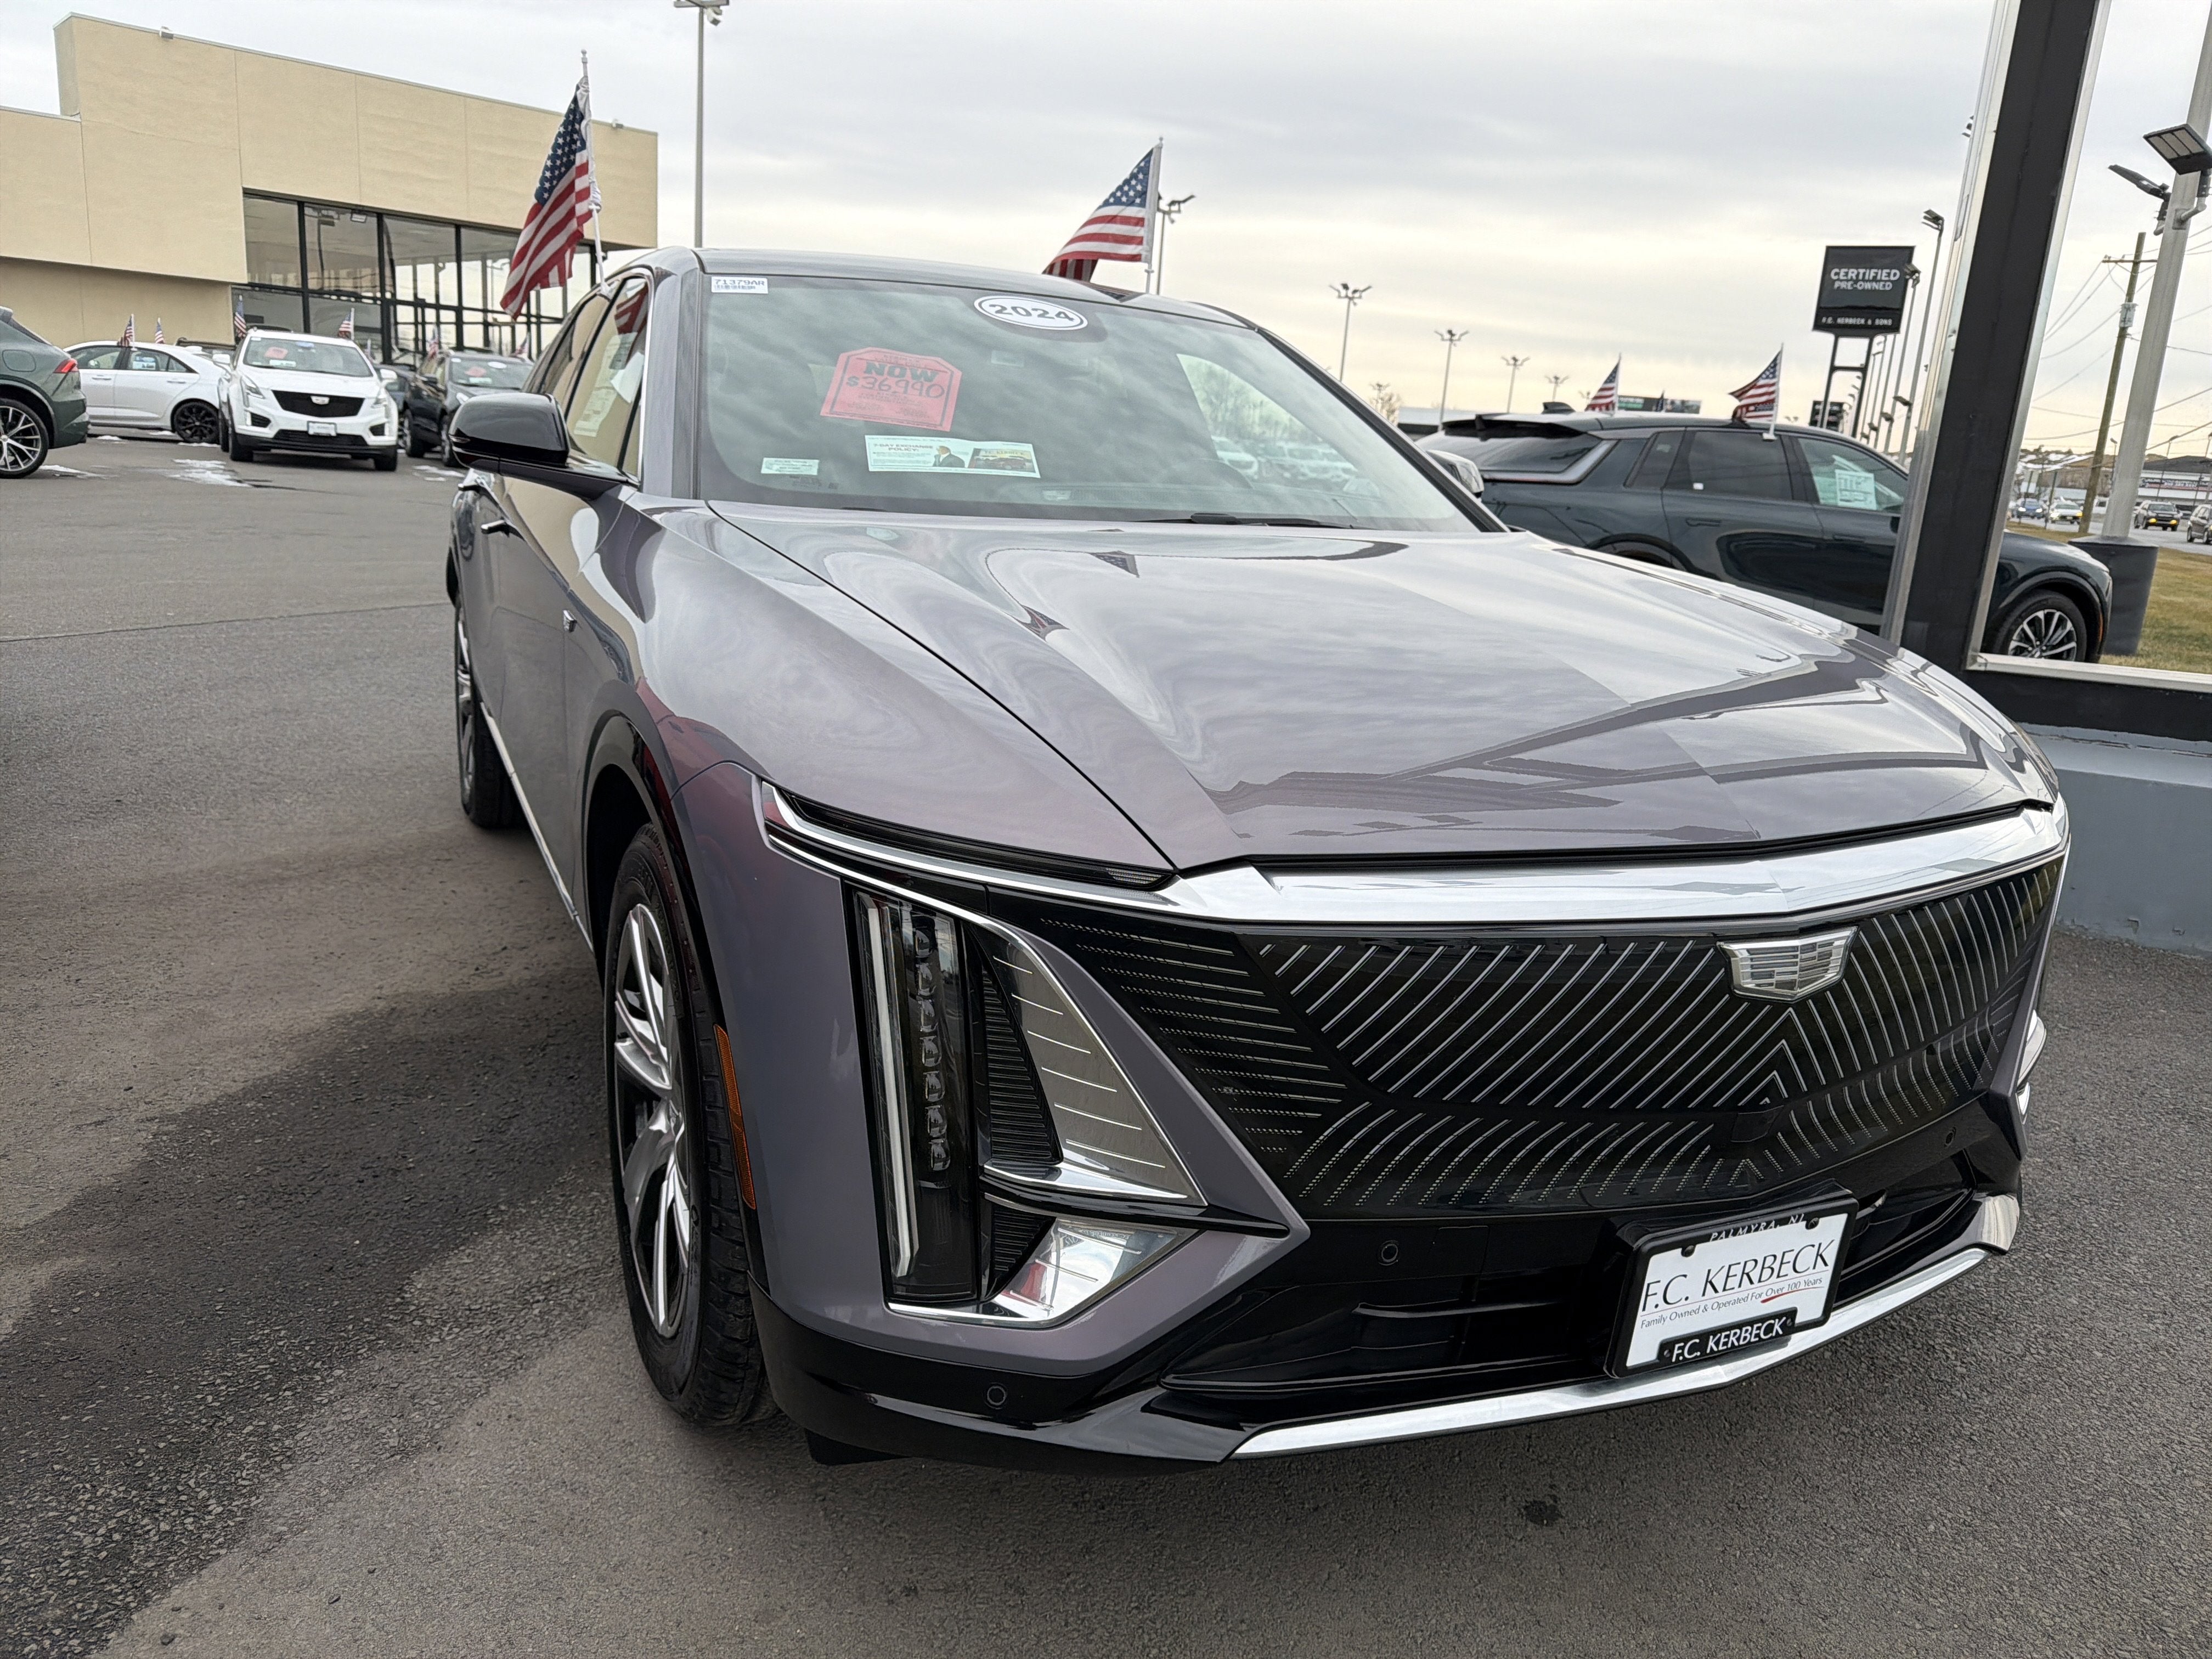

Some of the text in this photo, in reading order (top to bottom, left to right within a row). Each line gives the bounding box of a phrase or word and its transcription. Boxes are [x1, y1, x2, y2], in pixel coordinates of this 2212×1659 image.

[1830, 268, 1900, 281] CERTIFIED
[1834, 281, 1893, 291] PRE-OWNED
[989, 304, 1075, 322] 2024
[864, 362, 940, 382] NOW
[1641, 1239, 1835, 1312] F.C. KERBECK
[1640, 1277, 1823, 1329] Family Owned & Operated For Over 100 Years
[1672, 1317, 1787, 1363] F.C. KERBECK
